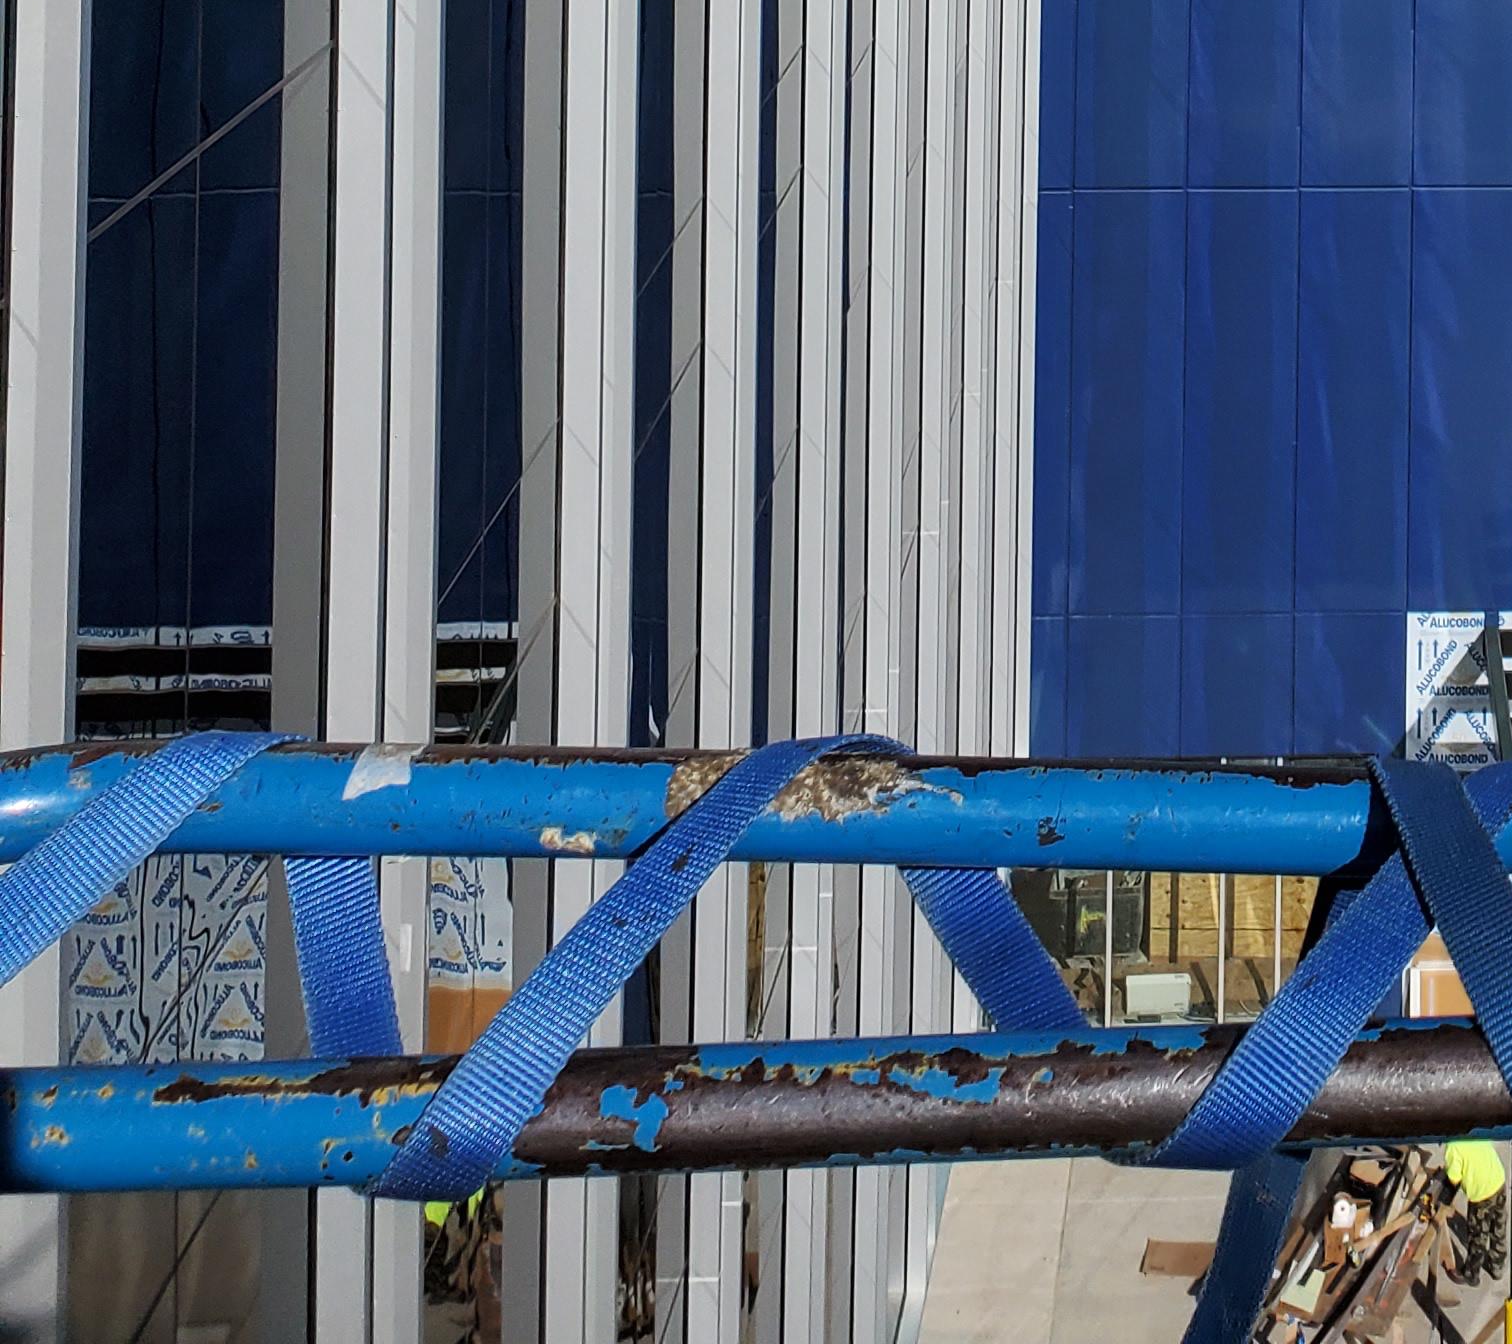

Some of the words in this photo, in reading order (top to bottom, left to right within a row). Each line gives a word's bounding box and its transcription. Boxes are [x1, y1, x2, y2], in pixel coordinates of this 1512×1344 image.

[1430, 616, 1483, 629] ALUCOBON
[1415, 639, 1458, 696] ALUCOBOND
[1429, 685, 1489, 697] ALUCOBOND
[1428, 752, 1489, 764] ALUCOBOND
